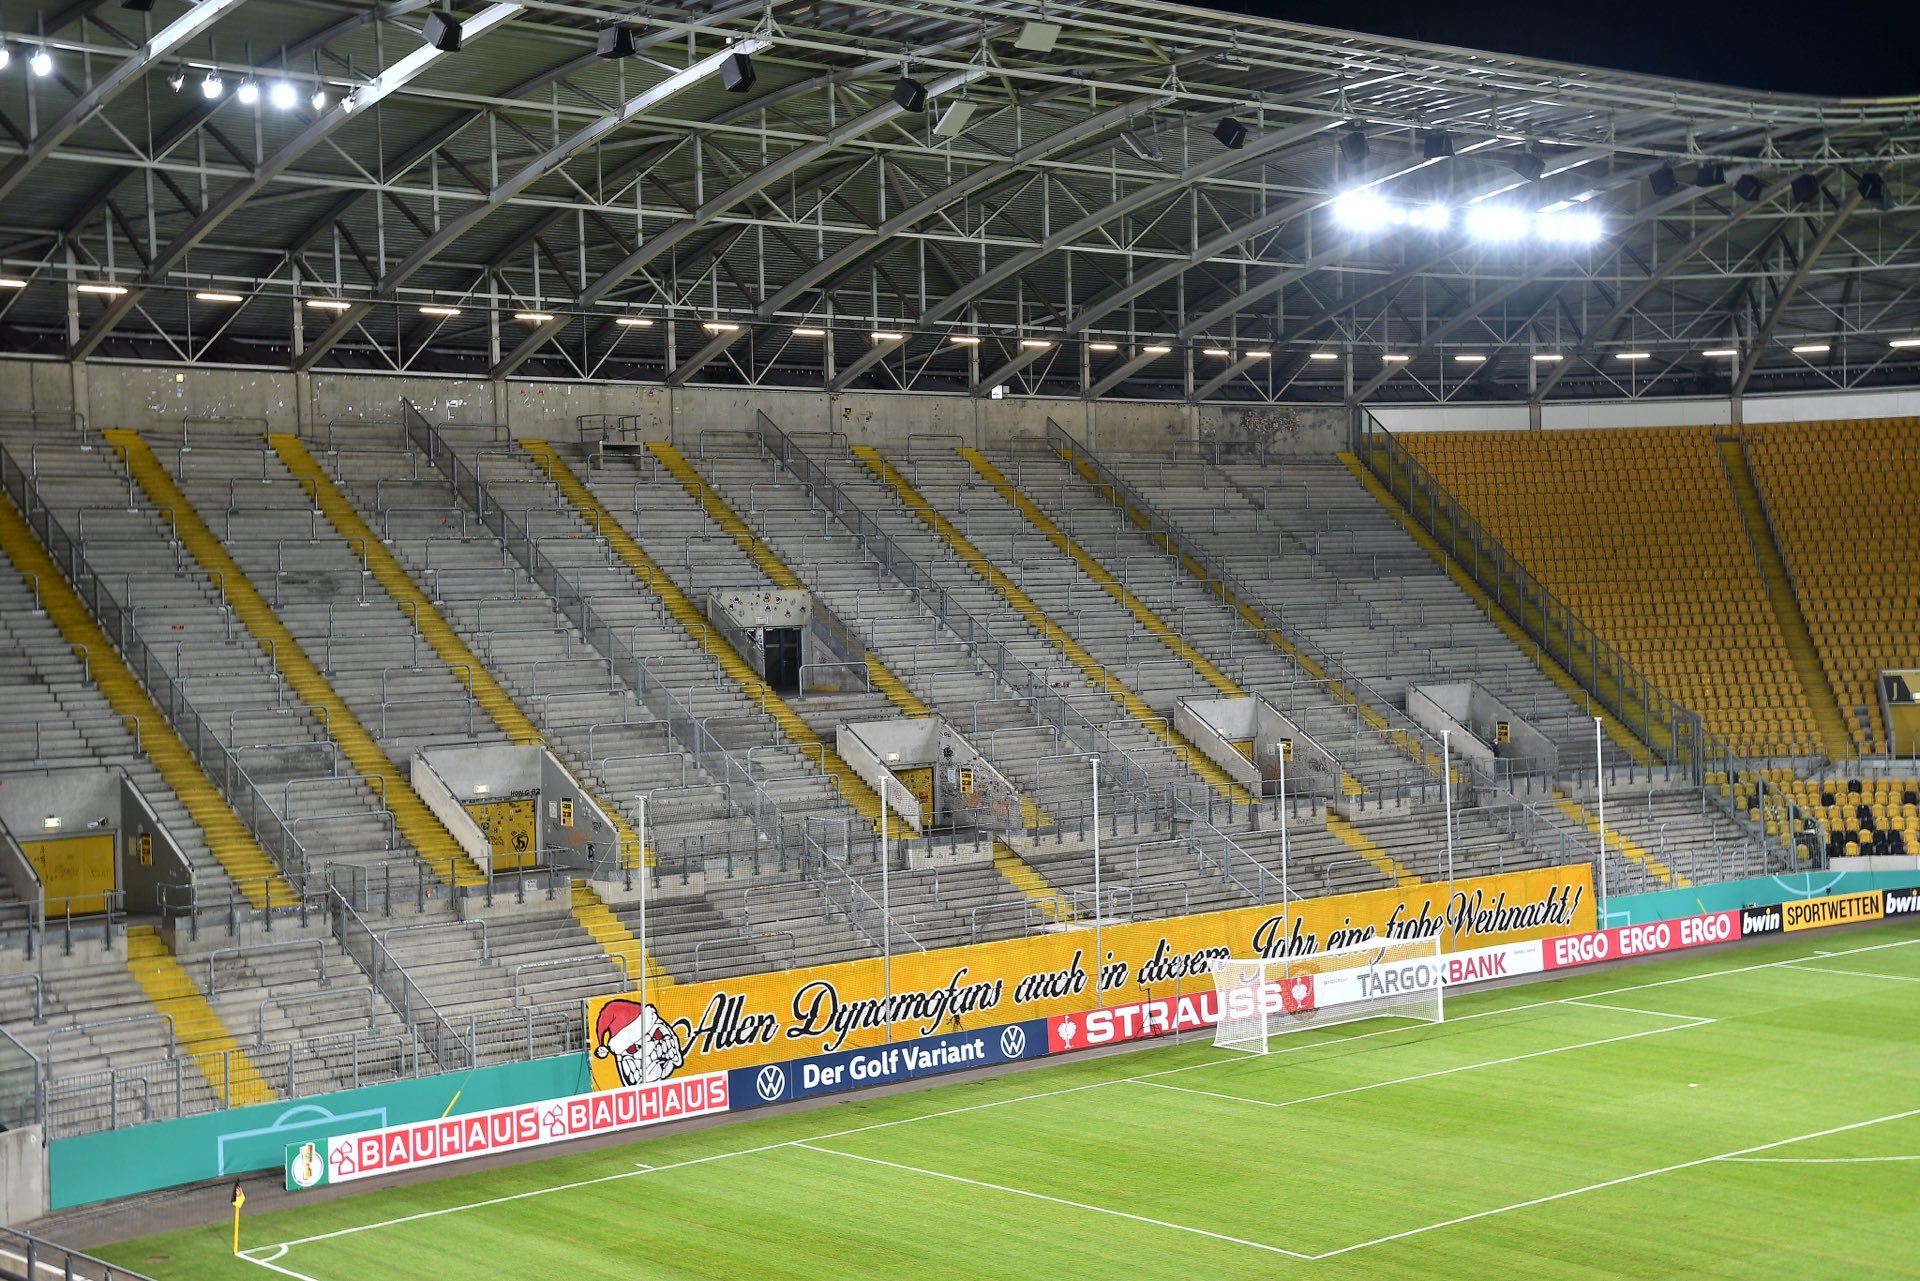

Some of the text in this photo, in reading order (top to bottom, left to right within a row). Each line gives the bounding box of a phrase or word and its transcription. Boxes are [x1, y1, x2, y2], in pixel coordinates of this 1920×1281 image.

[1555, 914, 1730, 965] ERGO ERGO ERGO
[1743, 908, 1780, 934] bwin
[1787, 895, 1880, 926] SPORTWETTEN
[672, 884, 1584, 1055] Allen Dynamofans auch in diesem Jahr eine frohe Weihnacht!
[1086, 983, 1283, 1043] STRAUSS
[803, 1063, 845, 1089] Der
[849, 1050, 898, 1080] Golf
[901, 1038, 984, 1071] Variant
[361, 1078, 727, 1167] BAUHAUS BAUHAUS
